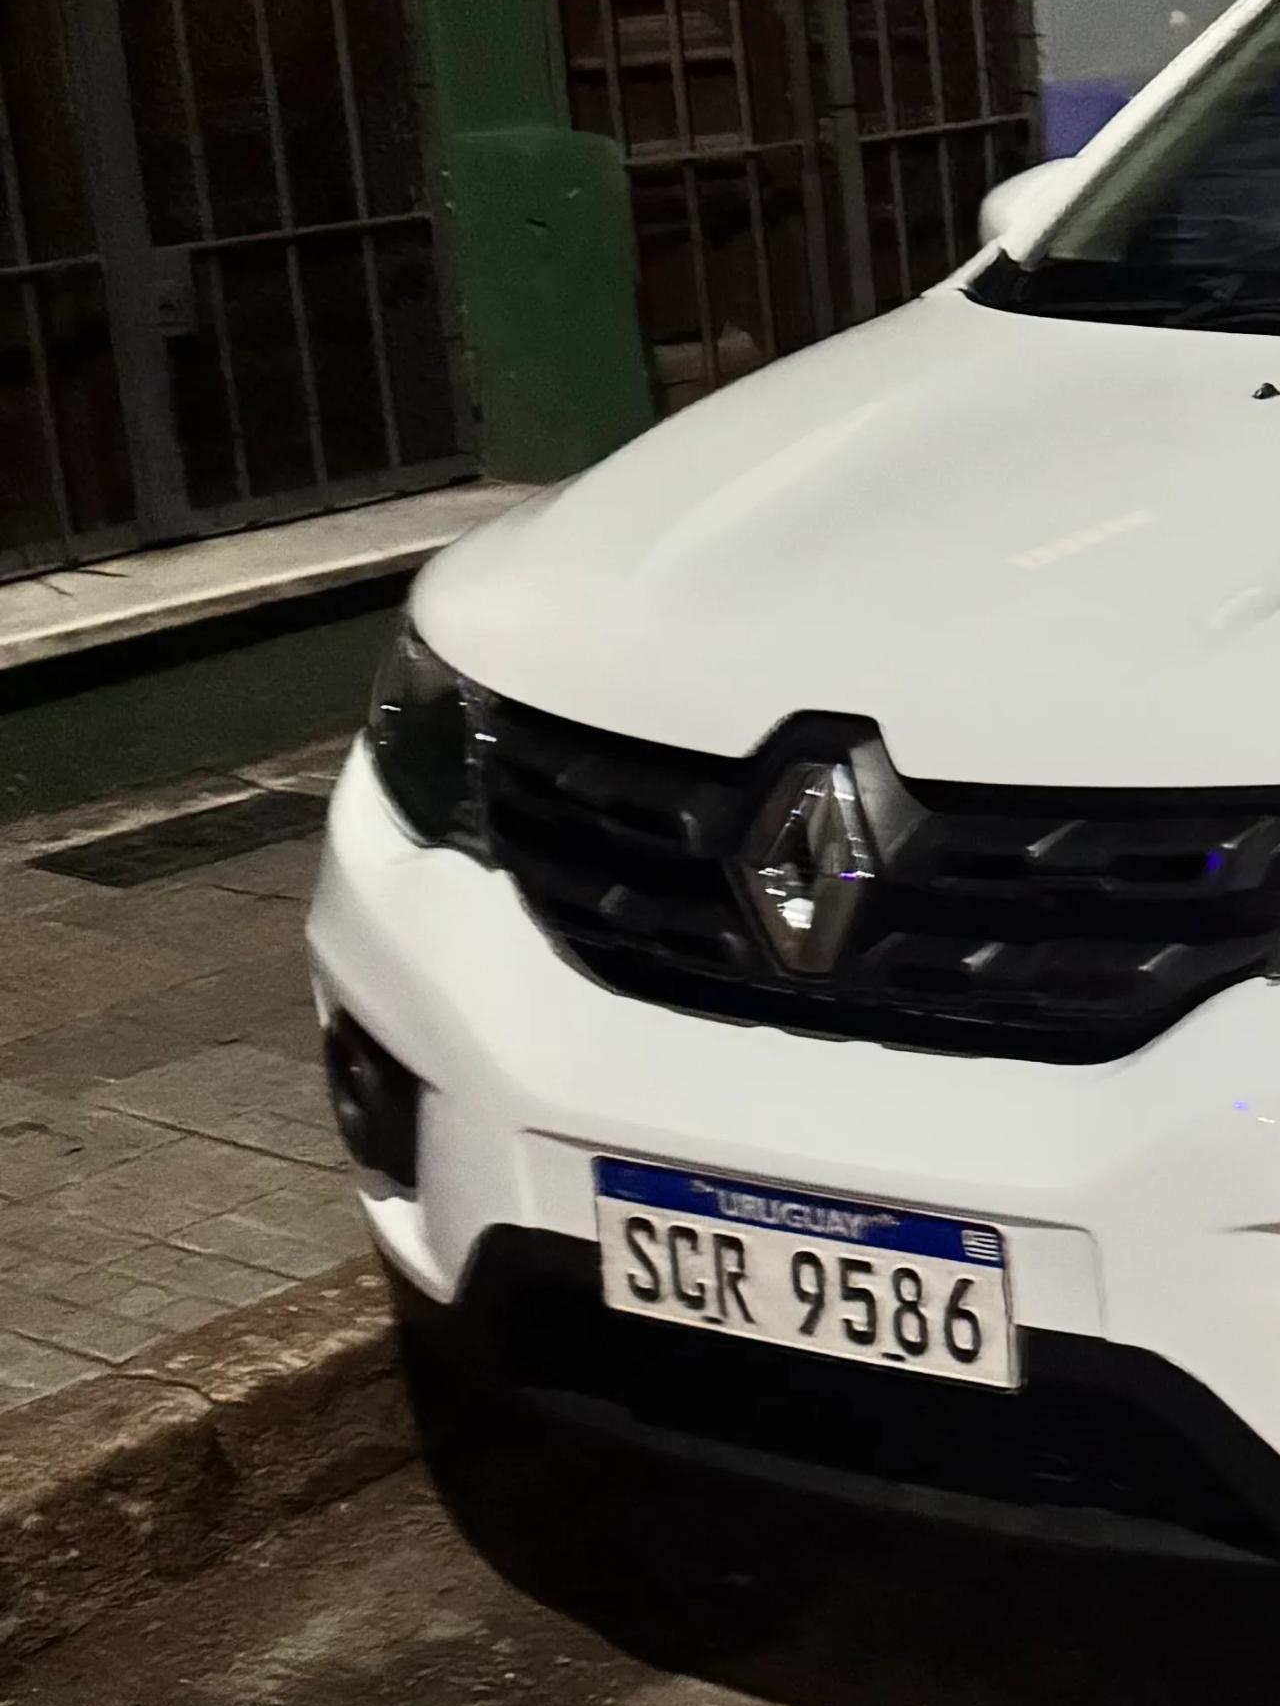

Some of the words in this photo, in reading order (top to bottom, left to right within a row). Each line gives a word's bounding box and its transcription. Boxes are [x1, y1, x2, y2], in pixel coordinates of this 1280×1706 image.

[717, 1190, 866, 1241] URUGUAY
[624, 1215, 757, 1325] SCR
[790, 1249, 982, 1363] 9586
